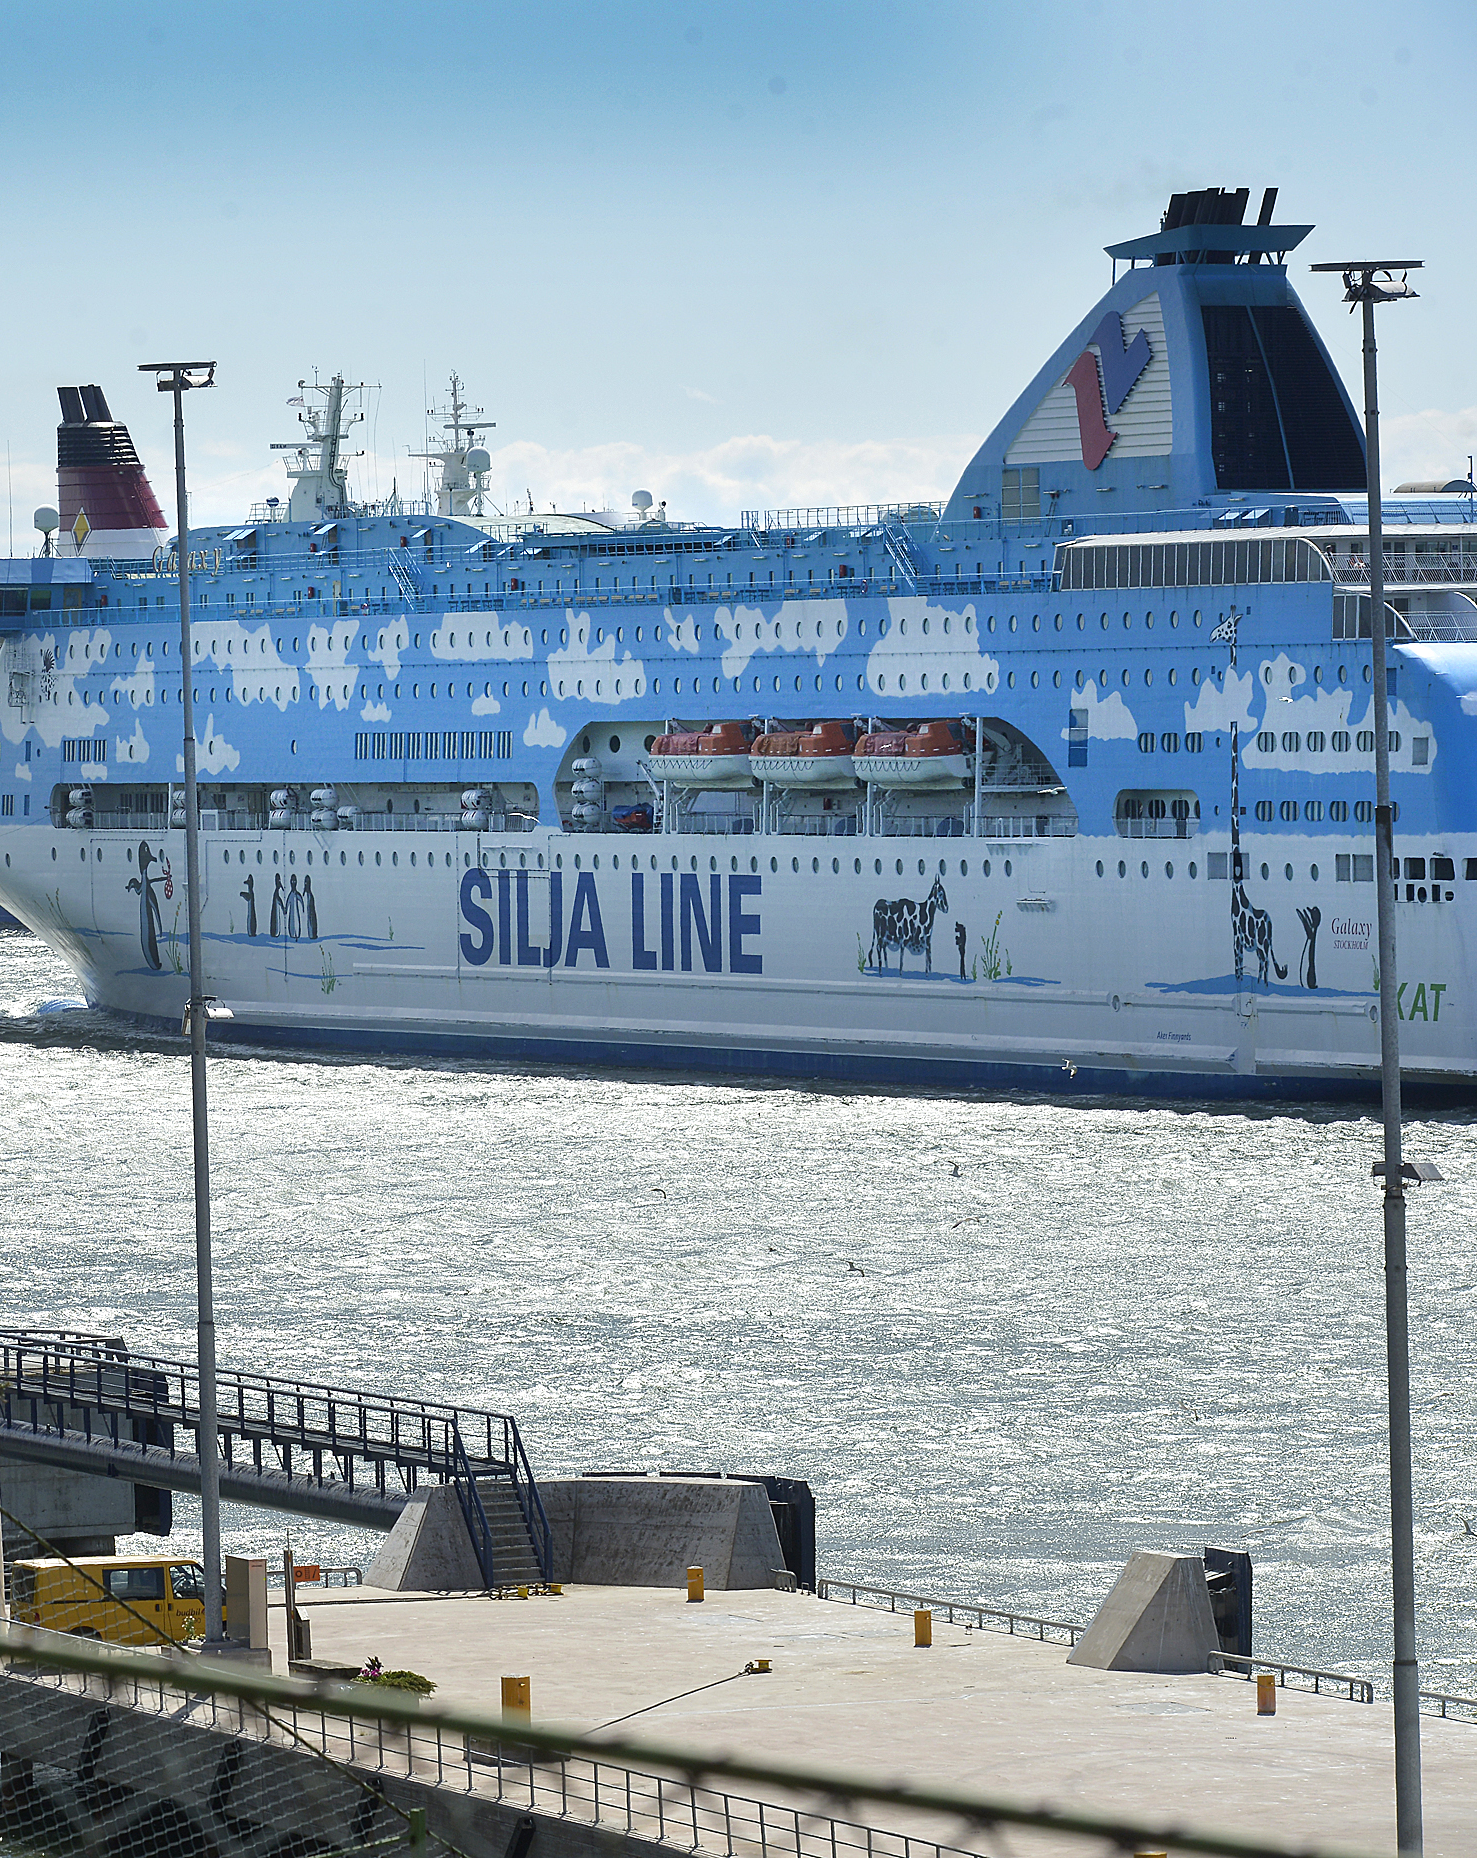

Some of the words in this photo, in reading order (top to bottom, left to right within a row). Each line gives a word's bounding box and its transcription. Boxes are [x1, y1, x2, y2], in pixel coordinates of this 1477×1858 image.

[153, 546, 223, 577] Gaaxy
[460, 868, 611, 968] SILJA
[632, 872, 763, 974] LINE
[1331, 917, 1372, 941] Galaxy
[1333, 940, 1369, 950] STOCKHOLM
